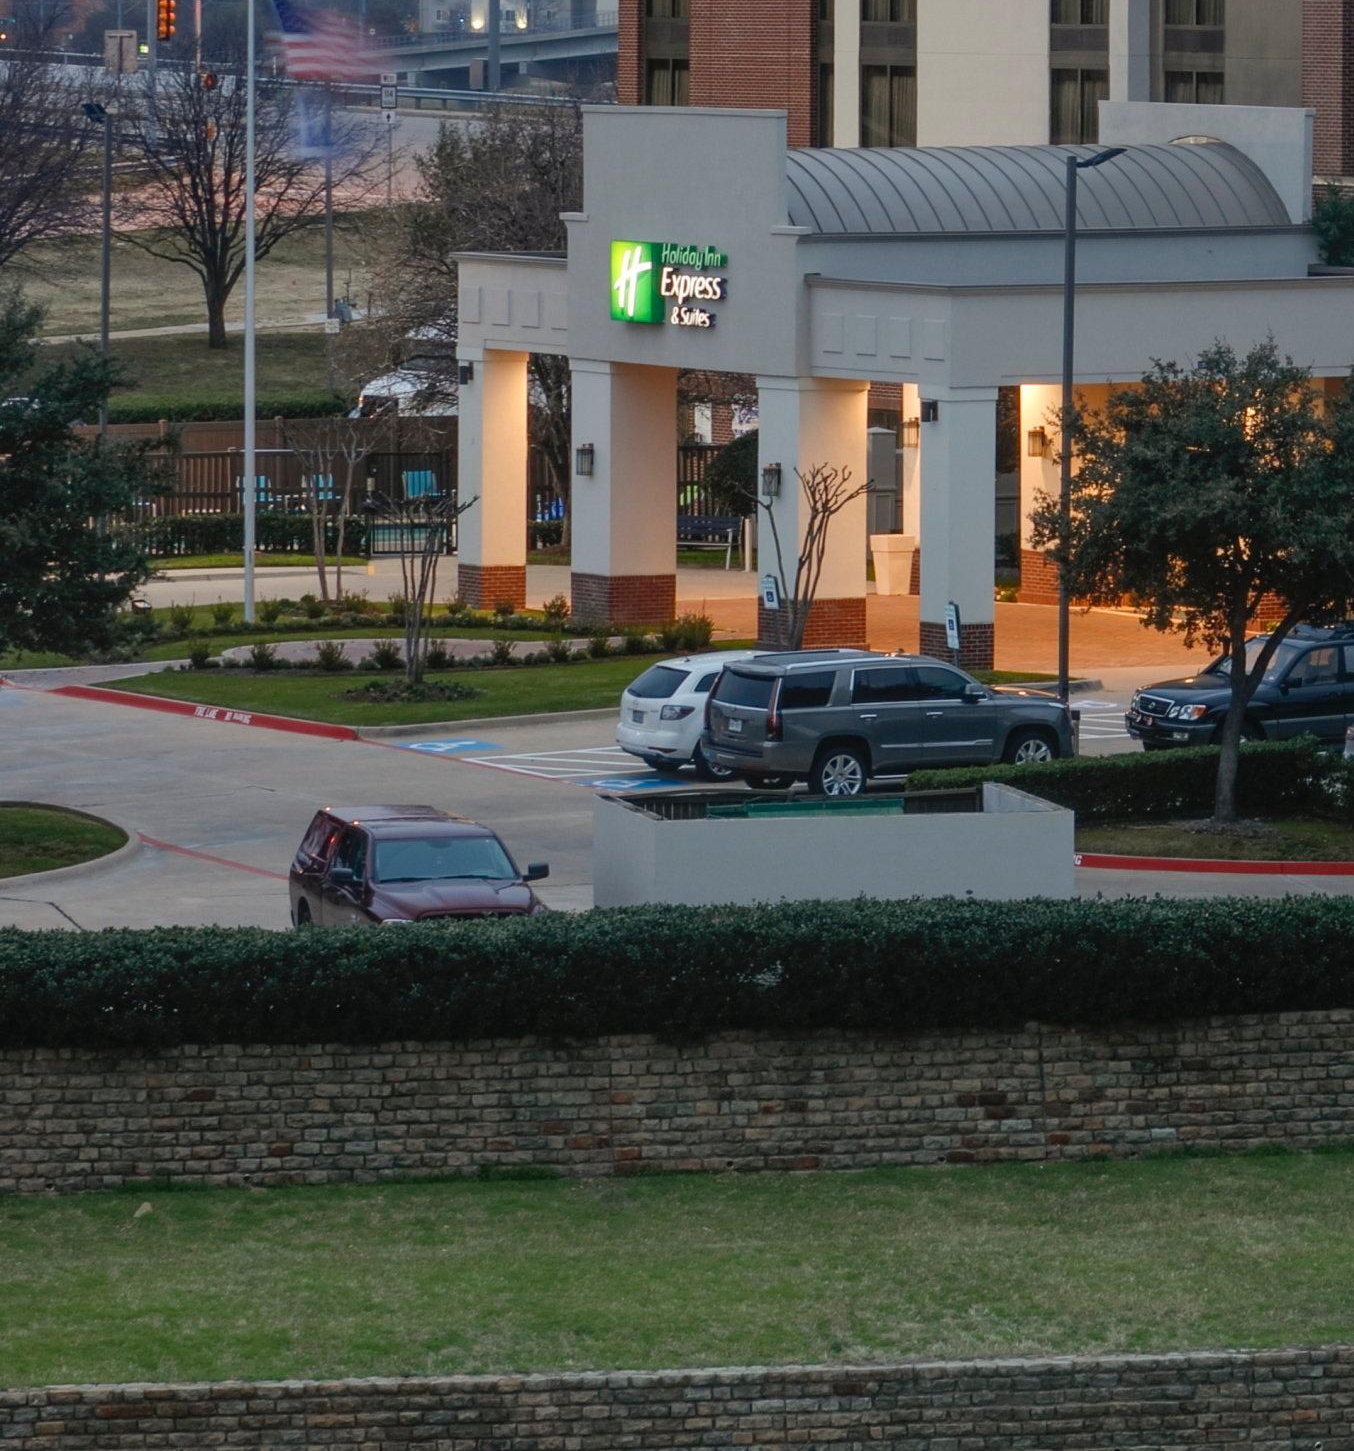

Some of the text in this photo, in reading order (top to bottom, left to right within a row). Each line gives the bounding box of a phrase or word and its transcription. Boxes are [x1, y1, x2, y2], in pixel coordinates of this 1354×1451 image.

[661, 243, 721, 271] Holiday Inn
[660, 266, 722, 305] Express
[670, 306, 711, 328] & Suites
